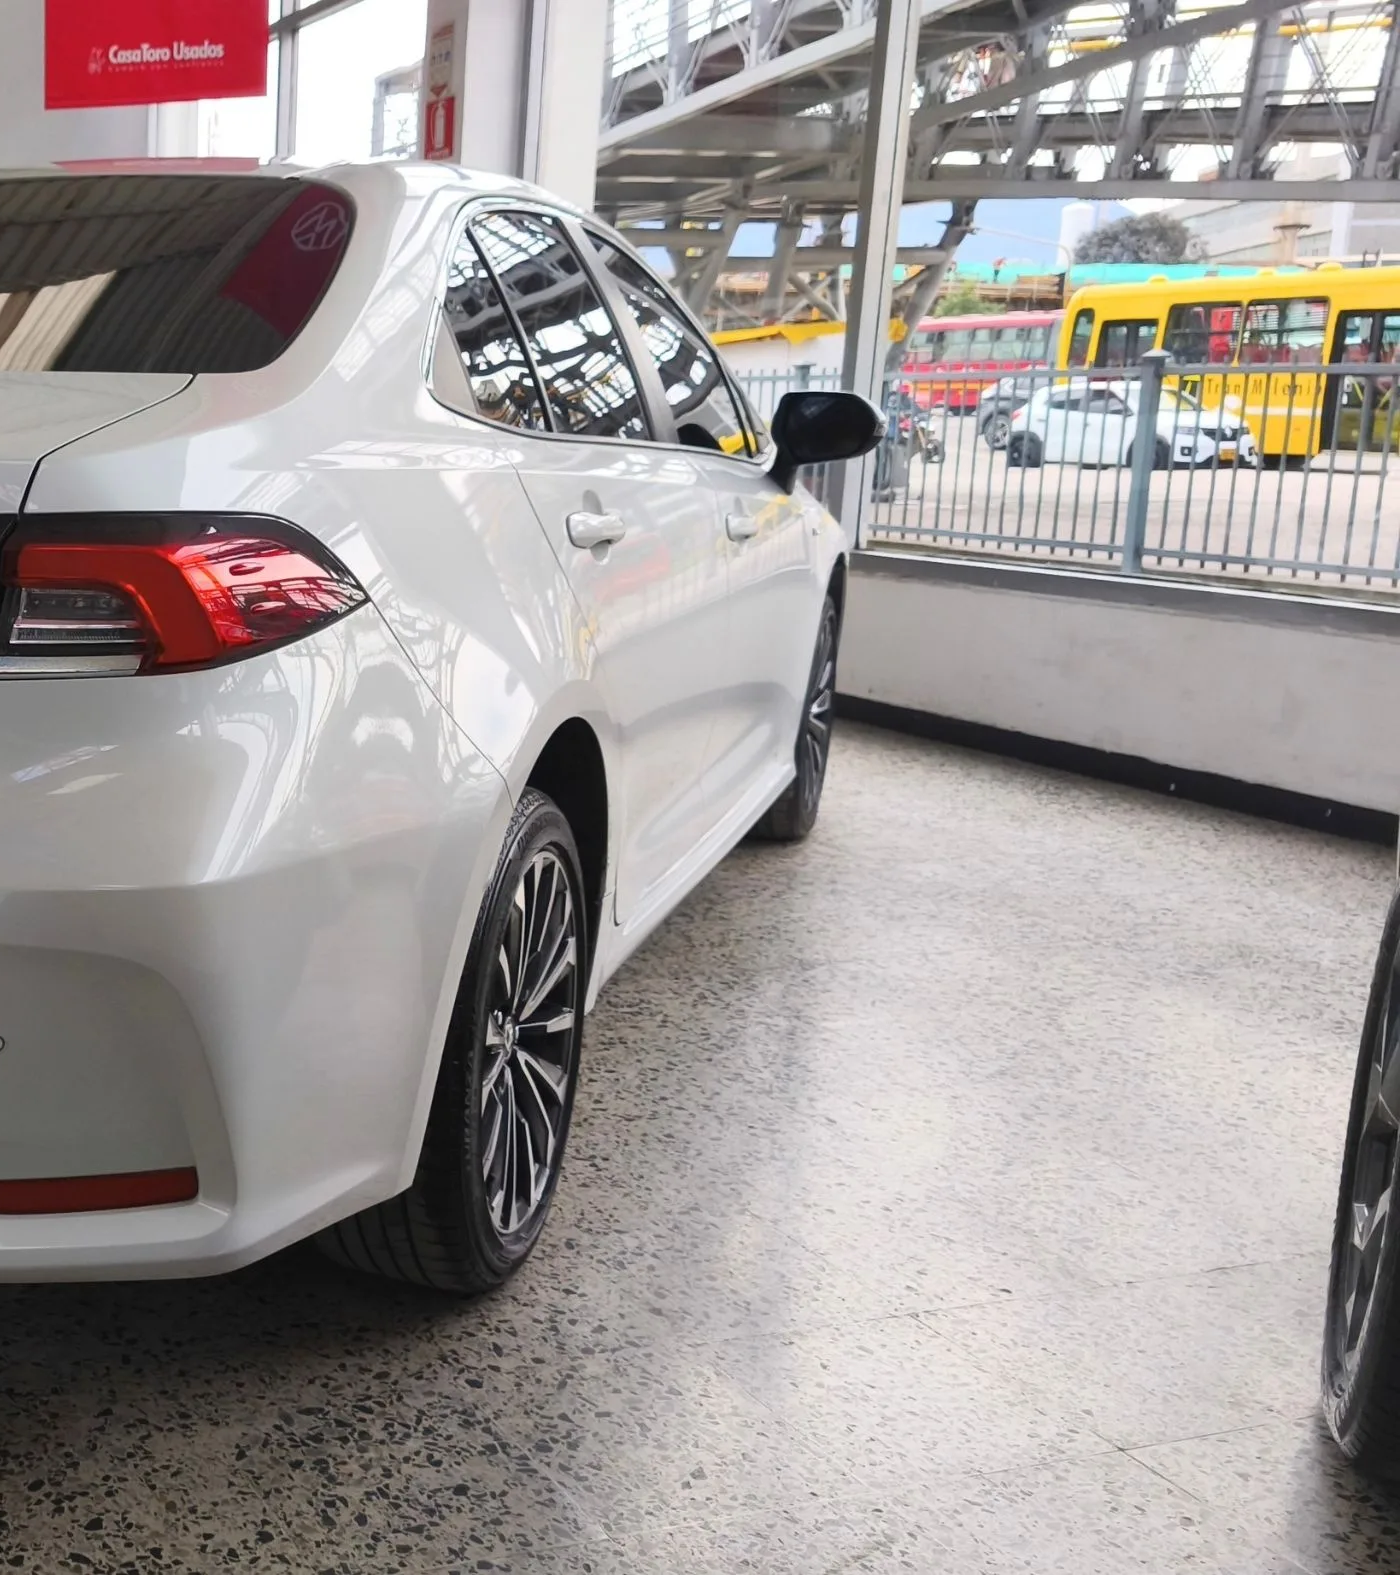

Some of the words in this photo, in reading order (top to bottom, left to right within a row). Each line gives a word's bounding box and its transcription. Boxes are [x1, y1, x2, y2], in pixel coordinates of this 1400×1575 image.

[108, 43, 170, 64] CasaToro
[173, 39, 224, 60] Usados
[1207, 376, 1323, 396] TrnMleni
